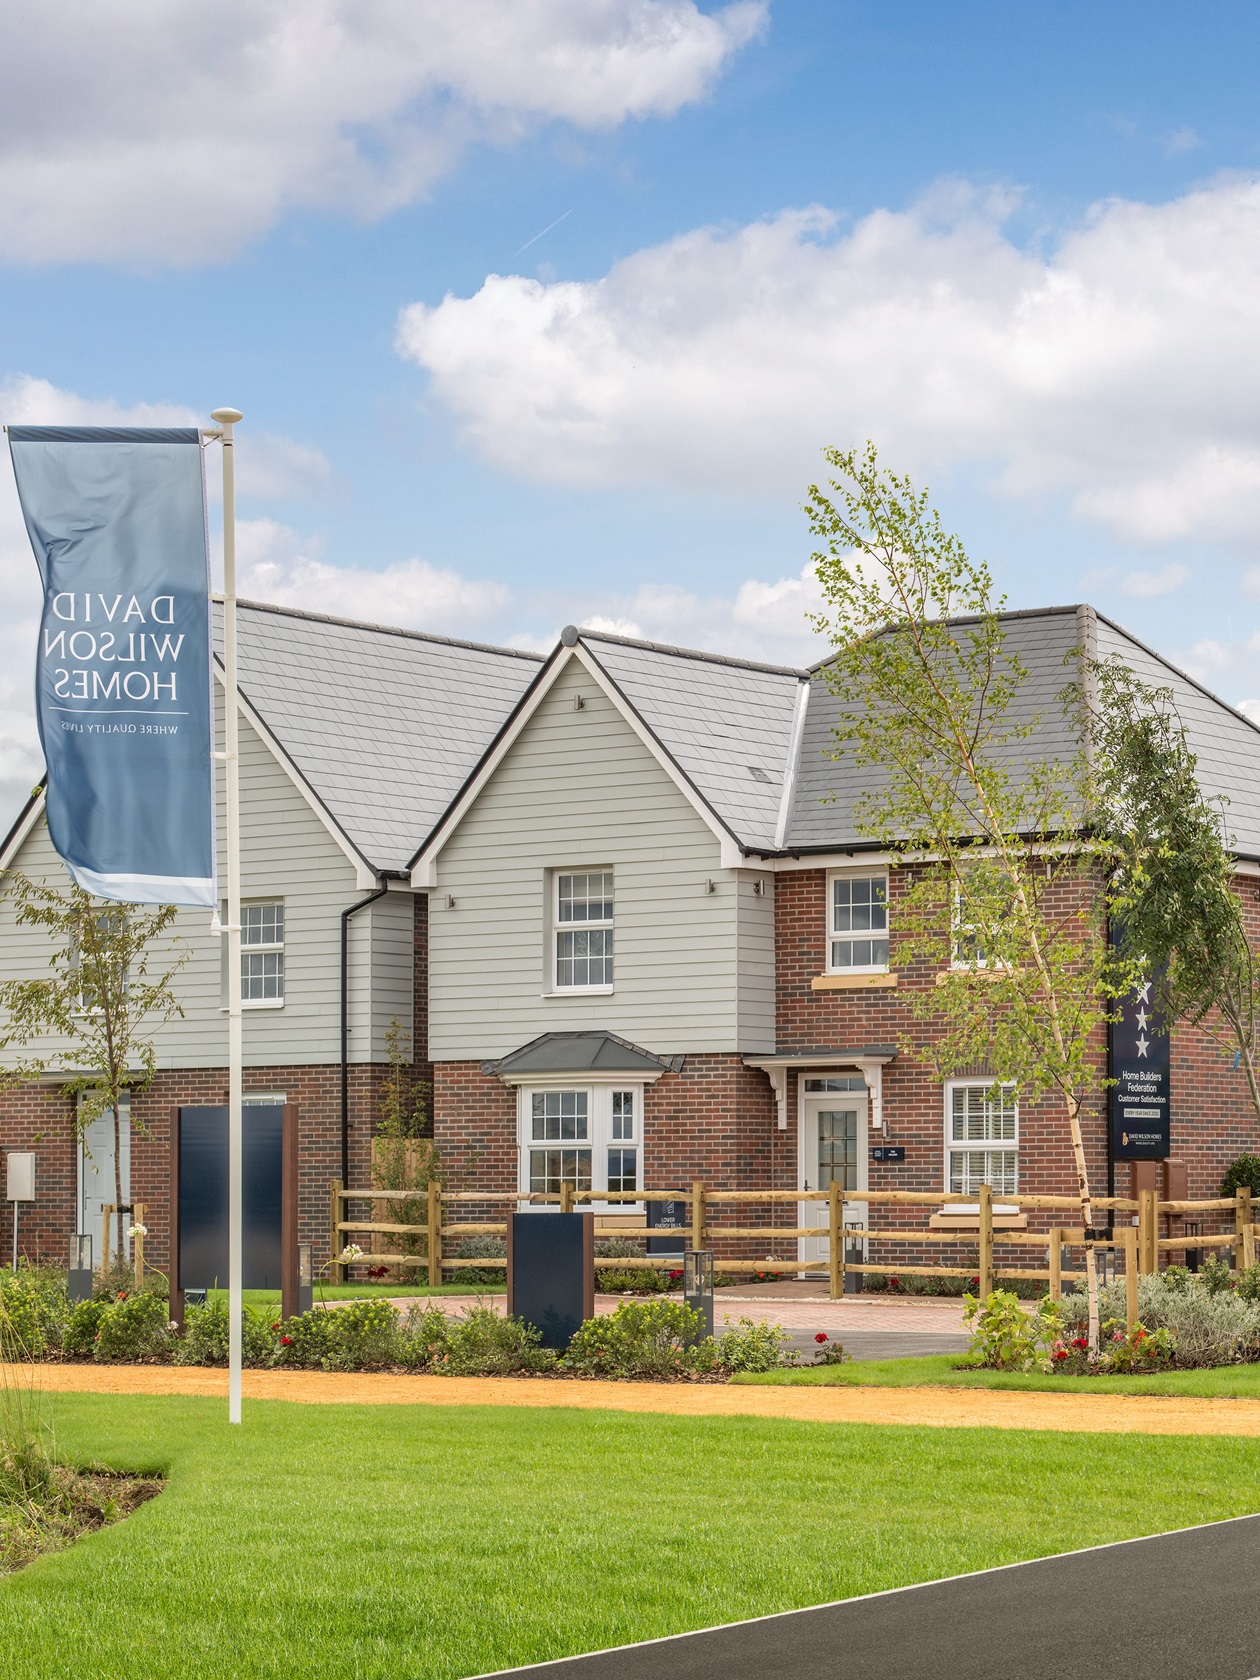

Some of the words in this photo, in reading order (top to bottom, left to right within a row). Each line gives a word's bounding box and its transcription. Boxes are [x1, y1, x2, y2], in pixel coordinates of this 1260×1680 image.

[1123, 1071, 1139, 1080] Home
[1140, 1071, 1162, 1081] Builders
[1128, 1083, 1157, 1092] Federation
[1141, 1095, 1166, 1103] Satisfaction
